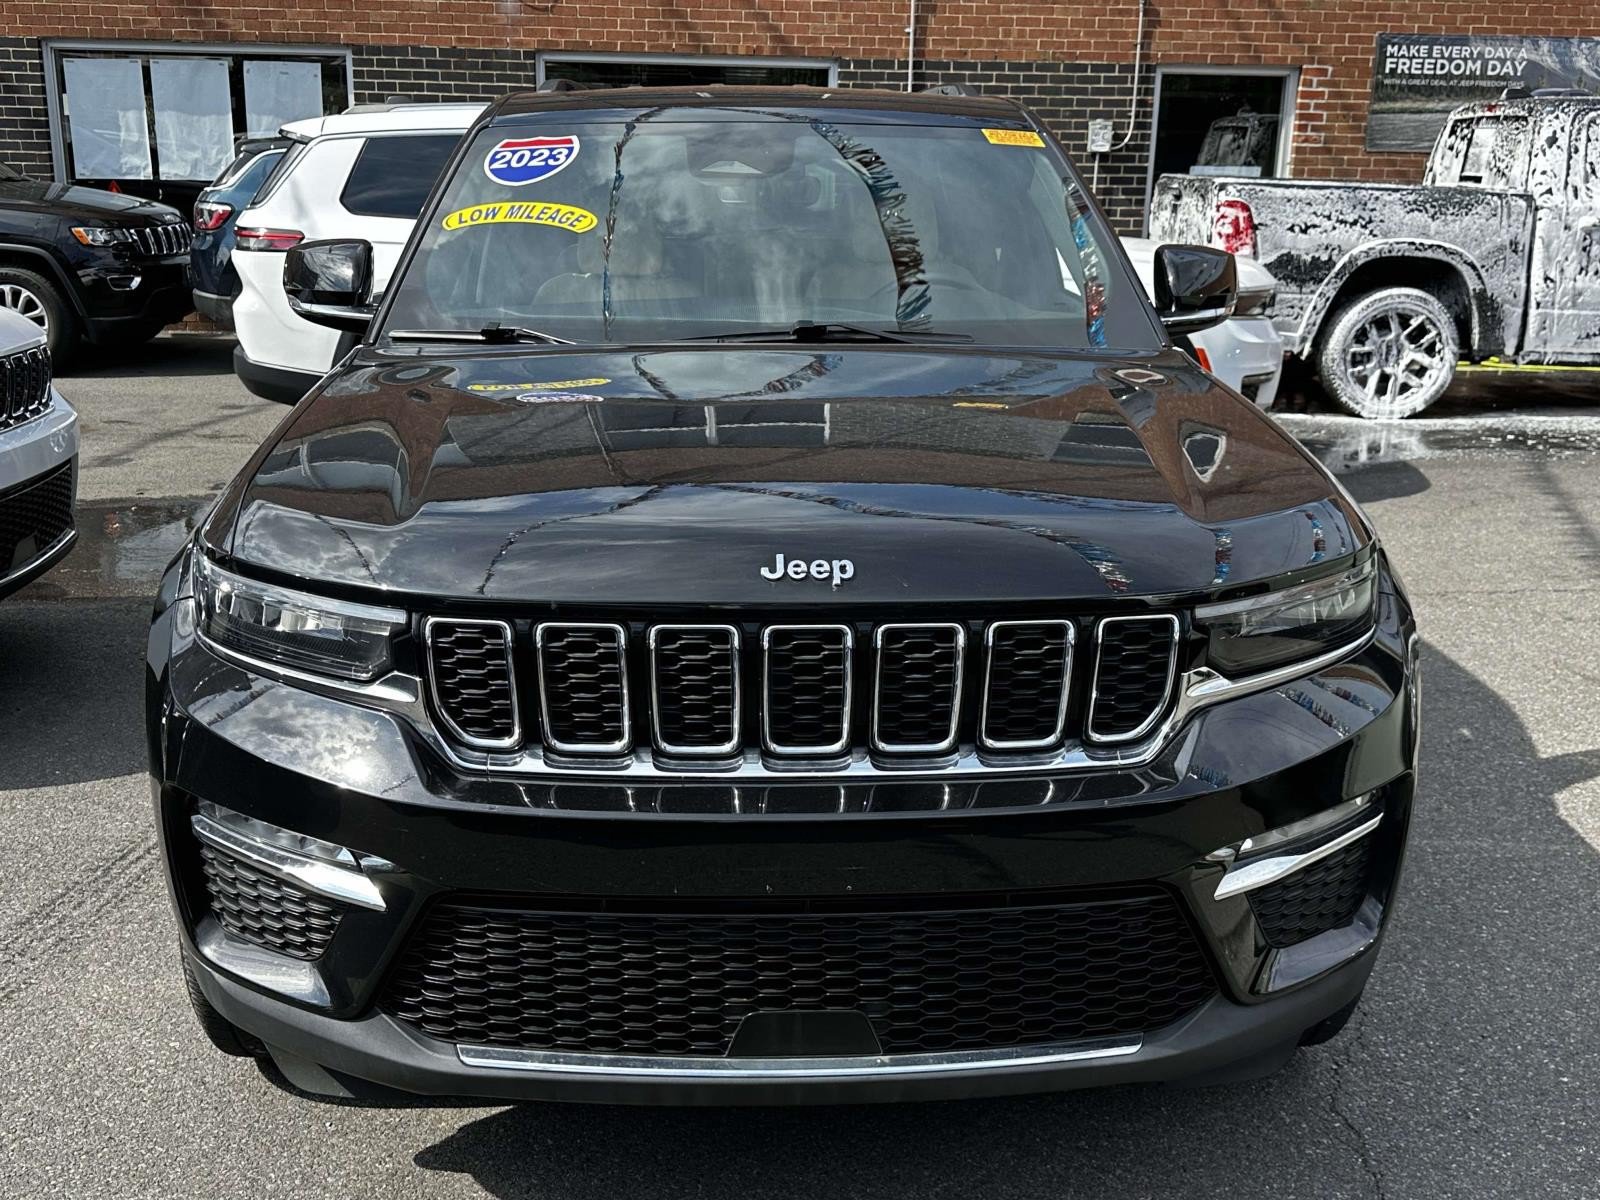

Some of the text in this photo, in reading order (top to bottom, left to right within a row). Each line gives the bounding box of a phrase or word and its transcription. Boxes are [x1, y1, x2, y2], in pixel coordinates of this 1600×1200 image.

[1386, 44, 1528, 60] MAKE EVERY DAY A
[1384, 57, 1528, 77] FREEDOM DAY
[1383, 78, 1401, 86] WITH
[1407, 78, 1430, 86] GREAT
[1430, 79, 1448, 87] DEAL
[1449, 79, 1458, 87] AT
[1458, 80, 1475, 88] JEEP
[1475, 80, 1507, 88] FREEDOM
[489, 148, 570, 170] 2023
[457, 203, 588, 229] LOW MILEAGE
[760, 553, 855, 586] Jeep
